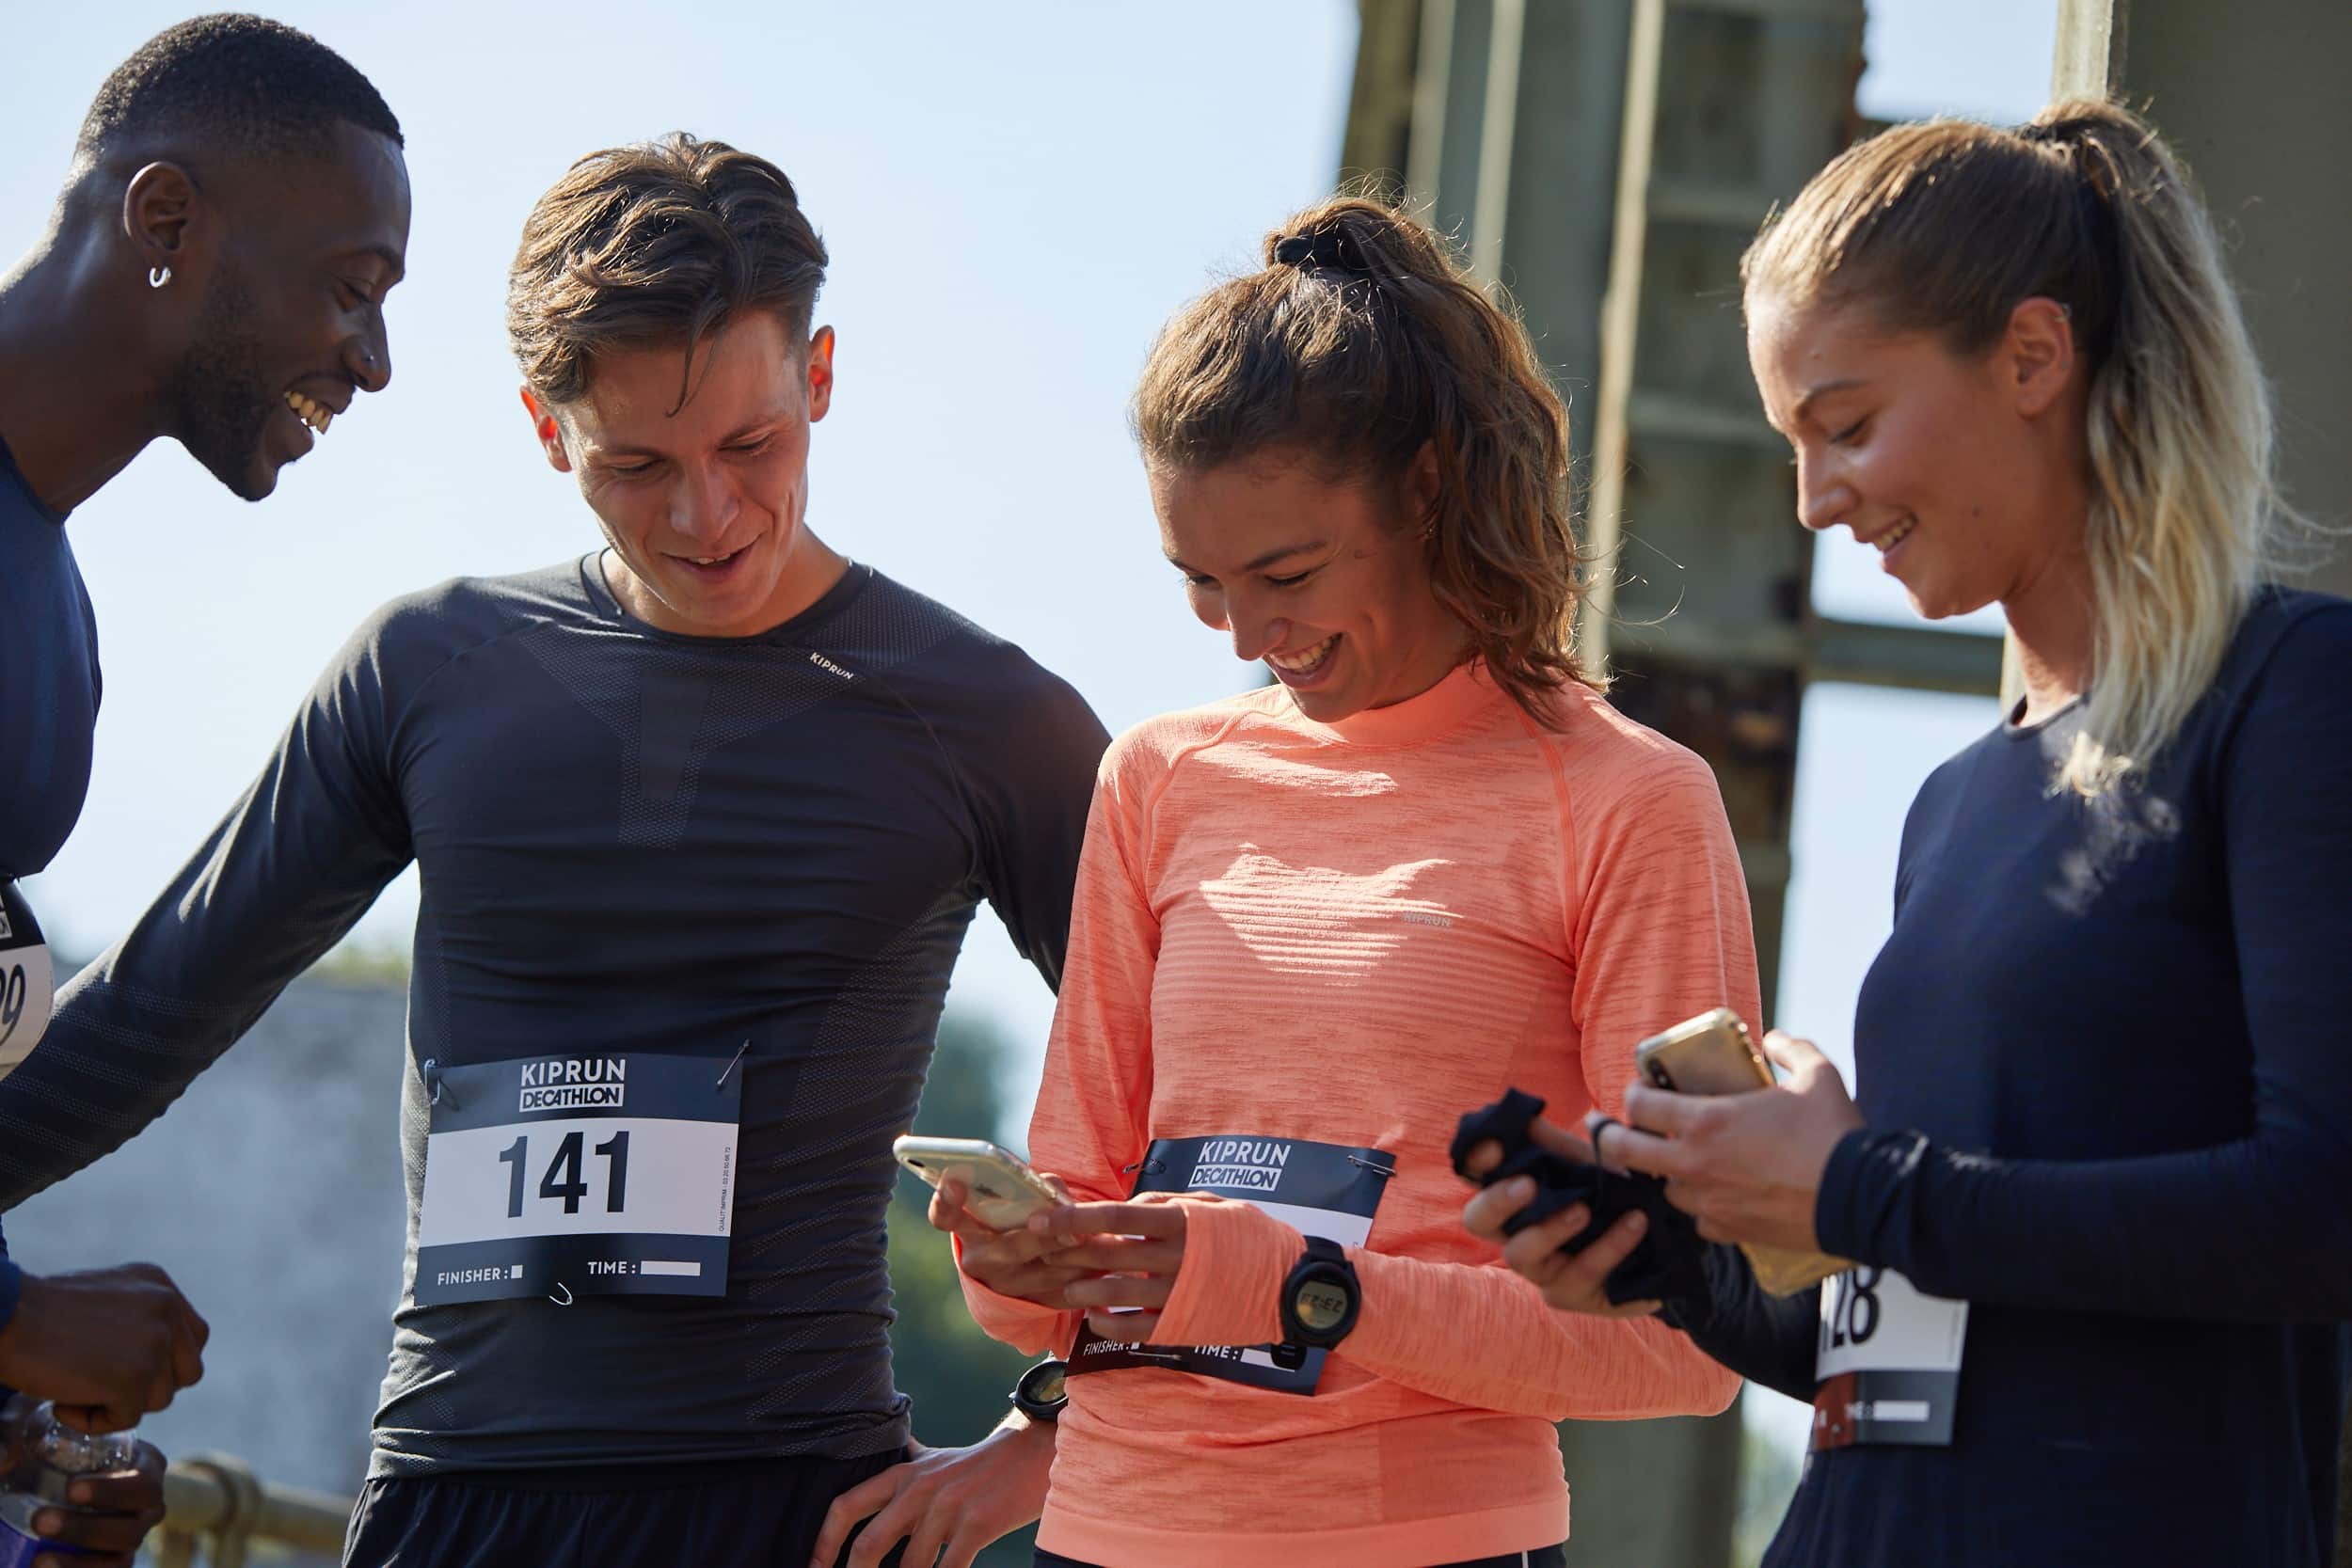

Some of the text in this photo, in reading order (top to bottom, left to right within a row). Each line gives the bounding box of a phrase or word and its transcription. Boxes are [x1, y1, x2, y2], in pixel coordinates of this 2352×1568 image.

[809, 651, 854, 680] KIPRUN
[0, 963, 25, 1047] 9
[519, 1058, 626, 1087] KIPRUN
[521, 1086, 621, 1110] DECATHLON
[1197, 1141, 1291, 1167] KIPRUN
[499, 1131, 629, 1218] 141
[1191, 1166, 1278, 1189] DECATHLON
[437, 1268, 501, 1285] FINISHER
[588, 1261, 628, 1274] TIME
